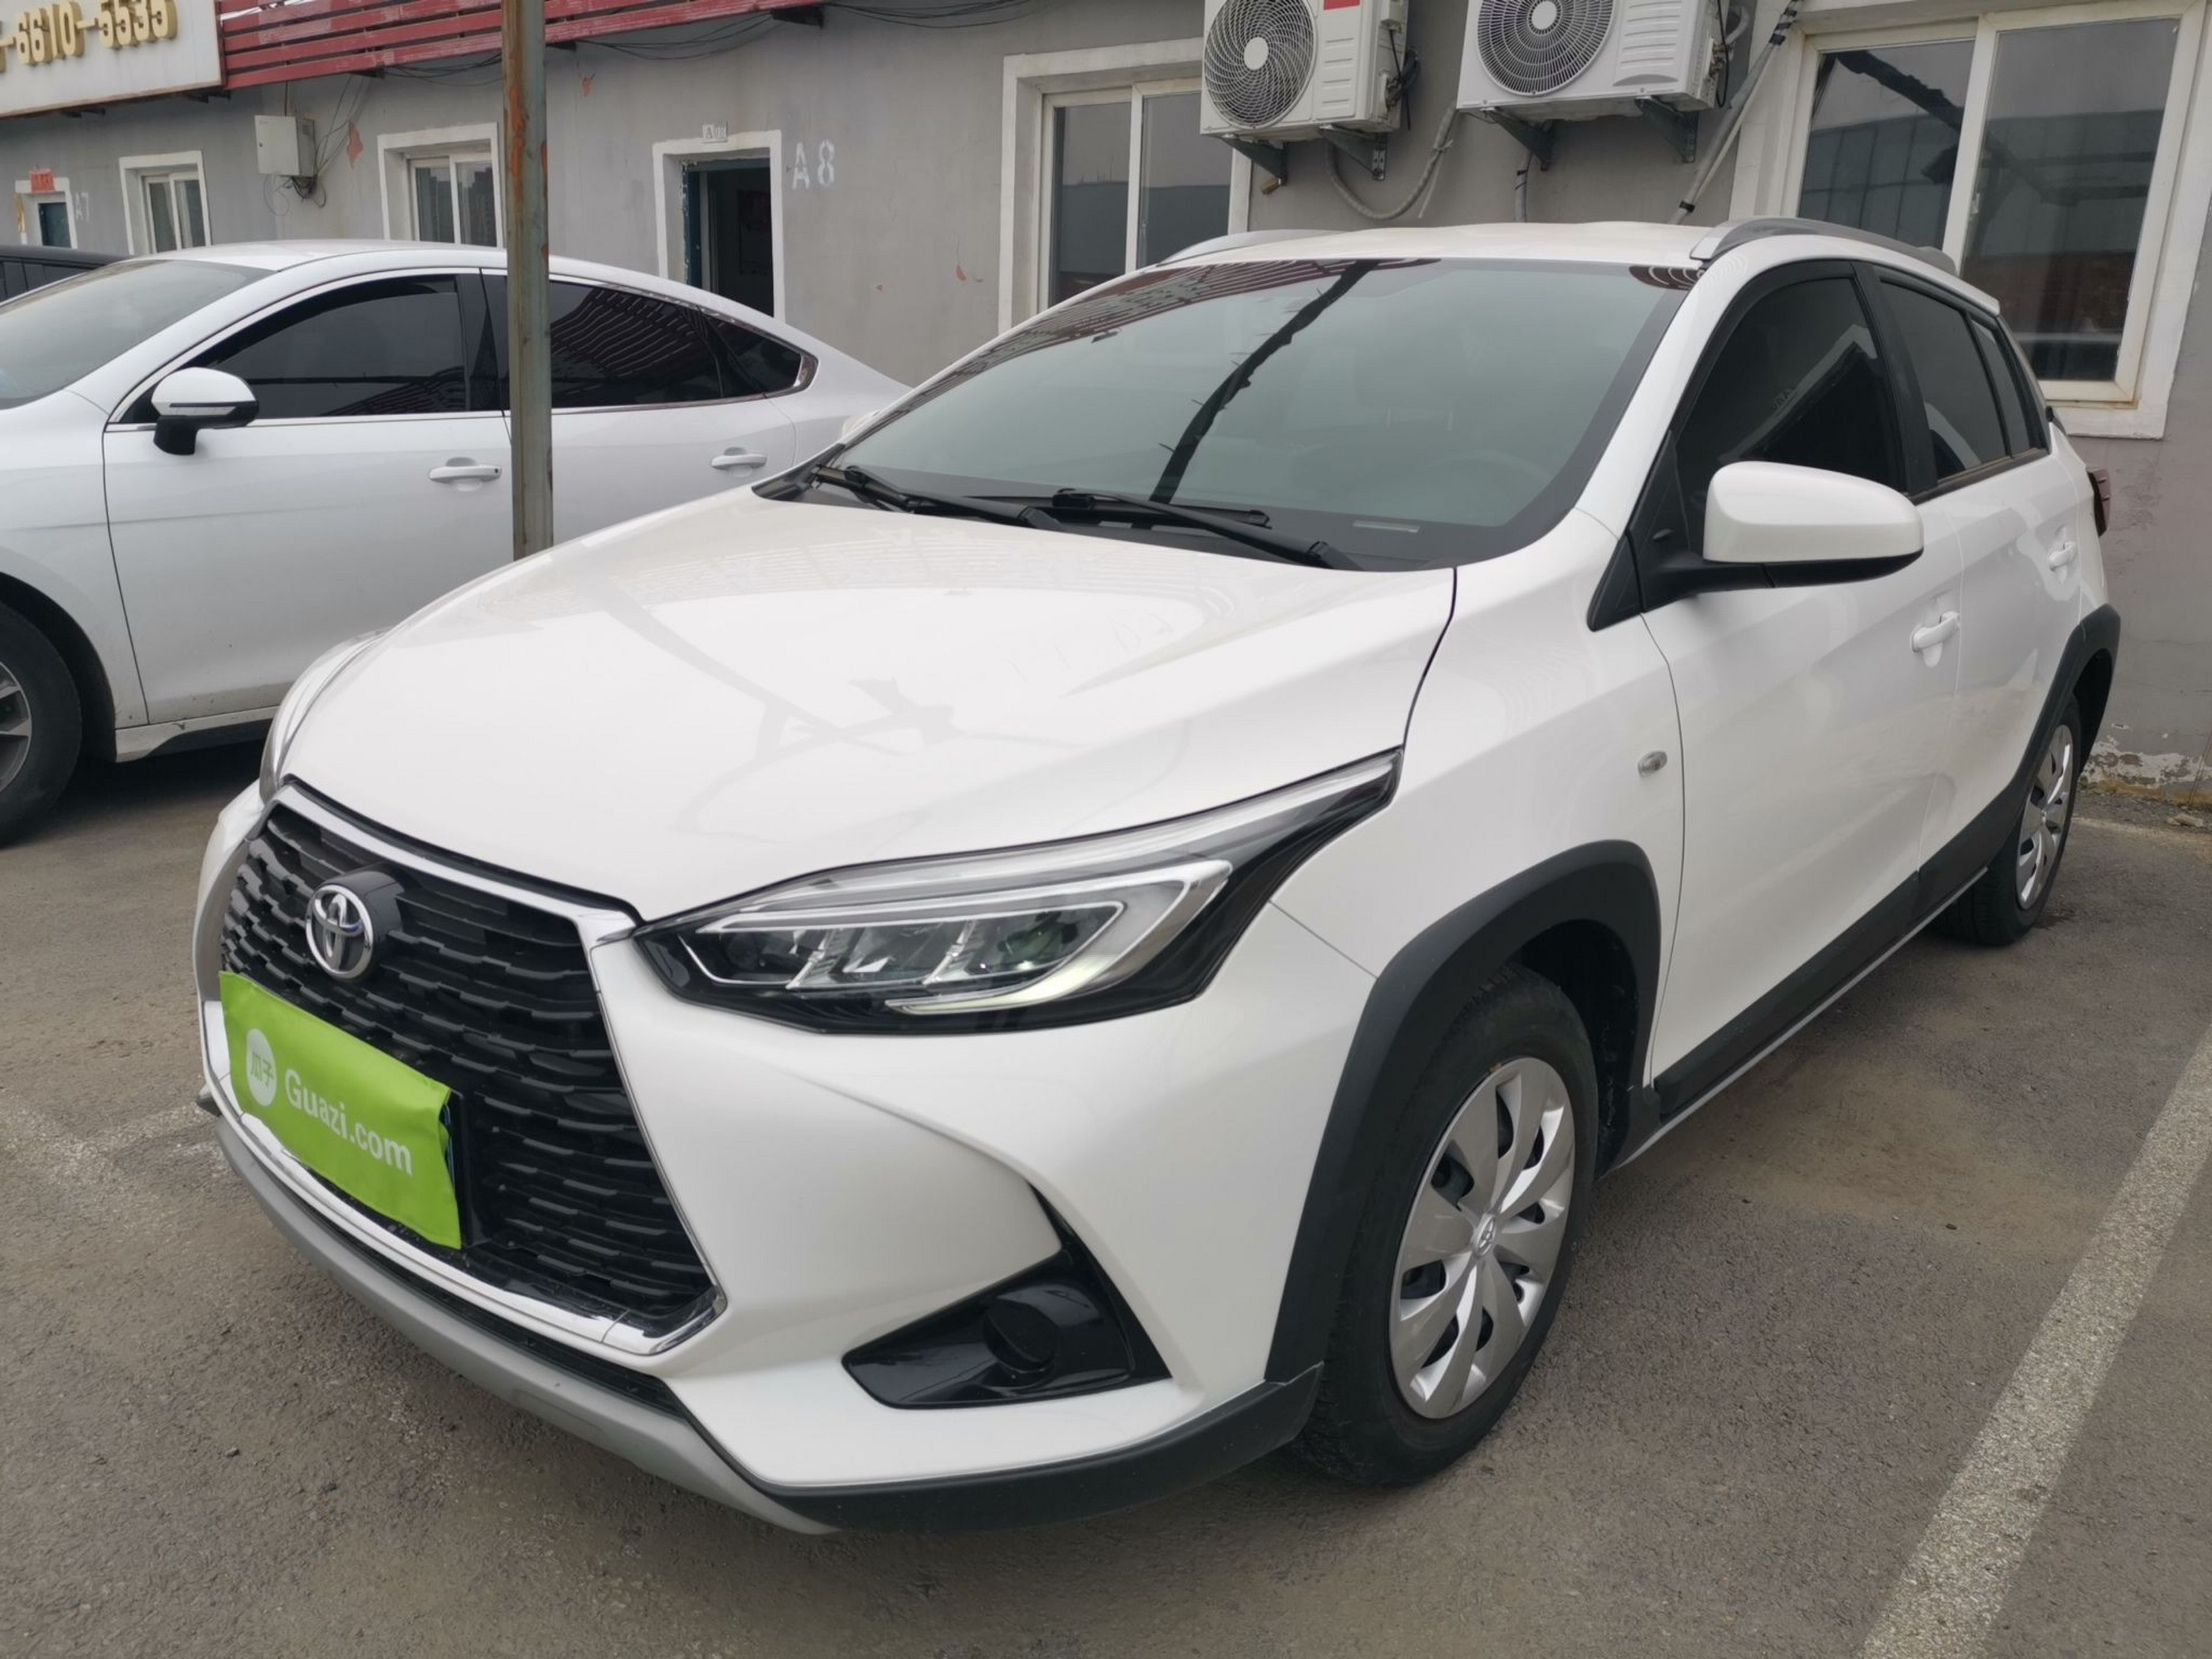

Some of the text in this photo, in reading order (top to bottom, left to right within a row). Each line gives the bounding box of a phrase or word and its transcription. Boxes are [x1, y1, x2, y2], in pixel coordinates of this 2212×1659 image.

[792, 139, 835, 189] A8
[250, 1050, 274, 1088] 瓜子
[285, 1069, 412, 1176] Guazi.com
